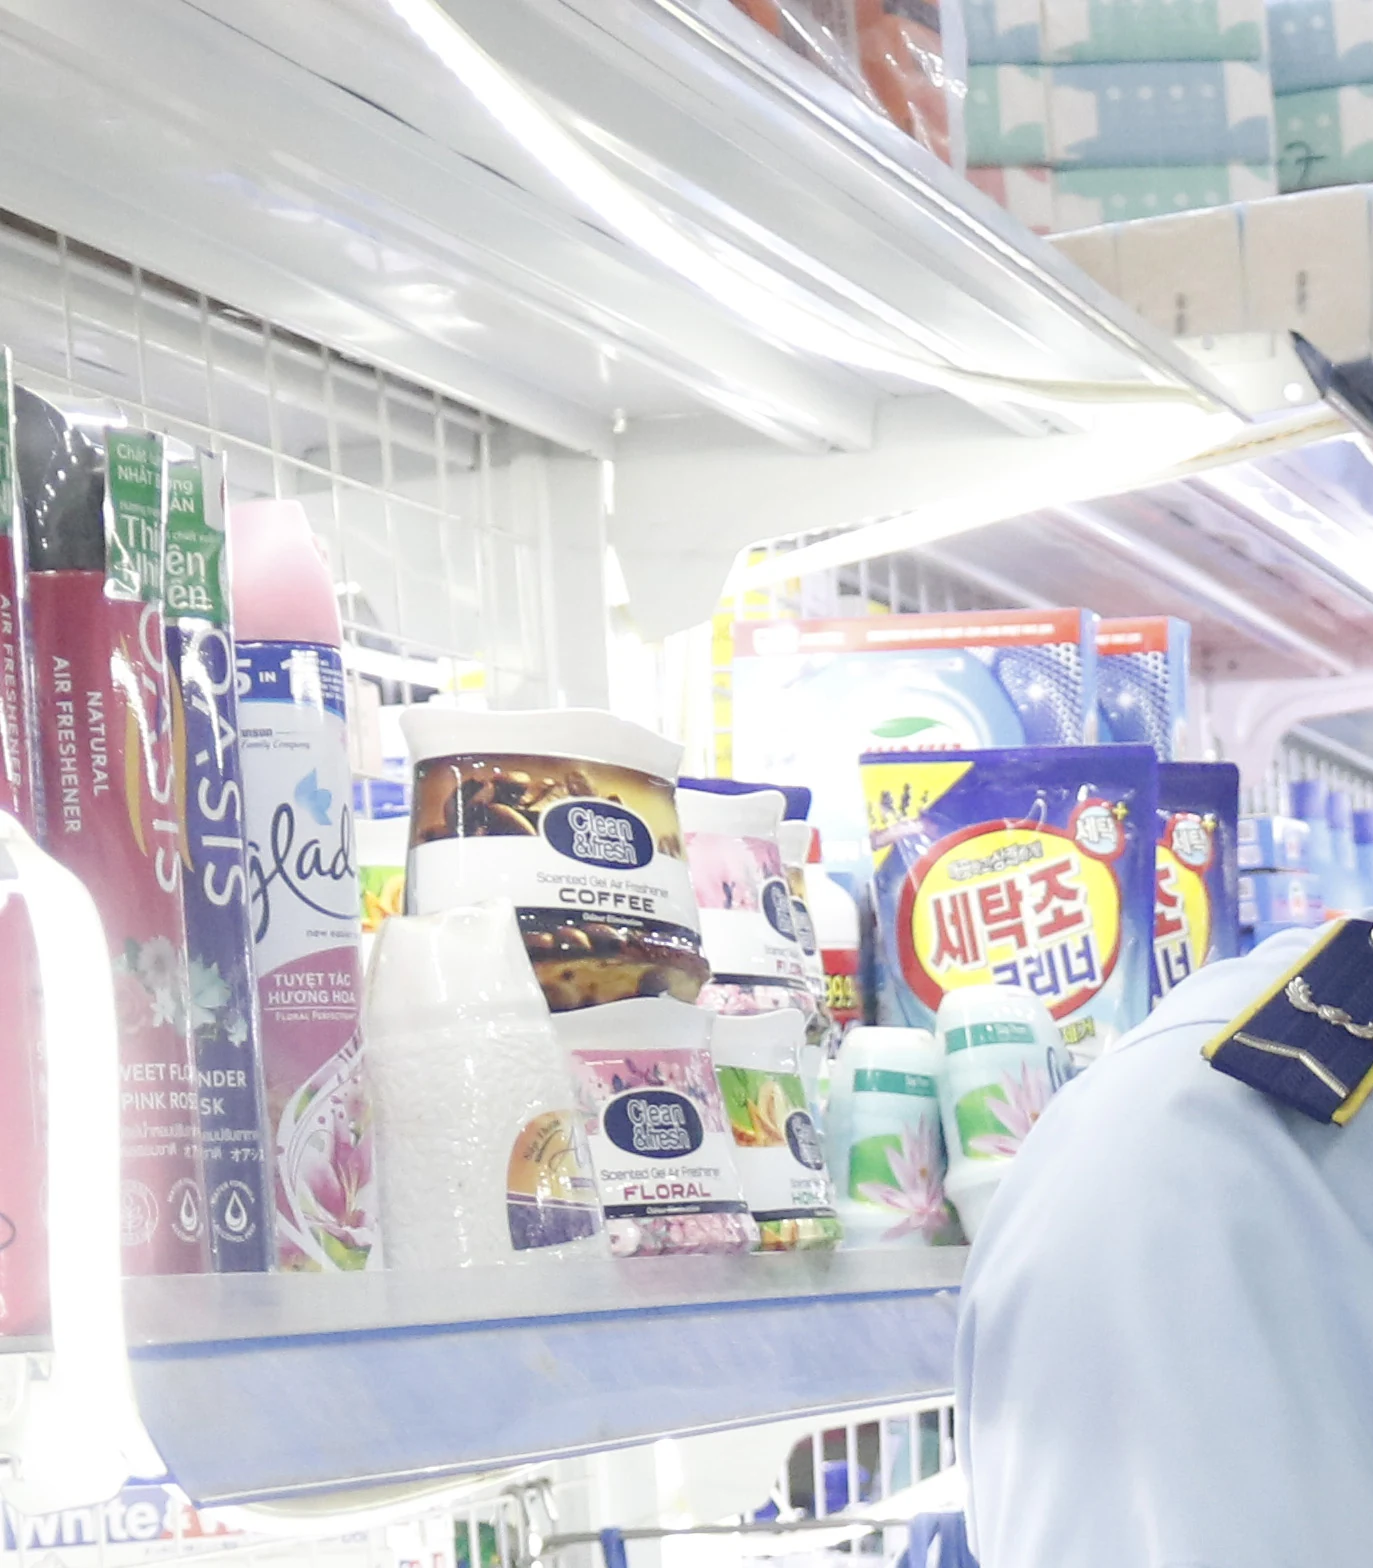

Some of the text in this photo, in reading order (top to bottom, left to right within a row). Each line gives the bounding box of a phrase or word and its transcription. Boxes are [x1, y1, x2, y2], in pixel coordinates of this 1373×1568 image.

[259, 671, 276, 683] IN
[53, 655, 83, 834] AIR FRESHENER
[86, 690, 111, 797] NATURAL
[568, 806, 634, 842] Clean
[574, 838, 637, 866] &fresh
[537, 871, 588, 886] Scented
[591, 876, 610, 888] Gel
[611, 878, 623, 888] Air
[559, 888, 657, 913] COFFEE
[930, 856, 1089, 969] 세탁조
[627, 1100, 686, 1129] Clean
[632, 1125, 692, 1152] &fresh
[600, 1167, 649, 1181] Scented
[652, 1168, 669, 1180] Gel
[623, 1182, 712, 1200] FLORAL
